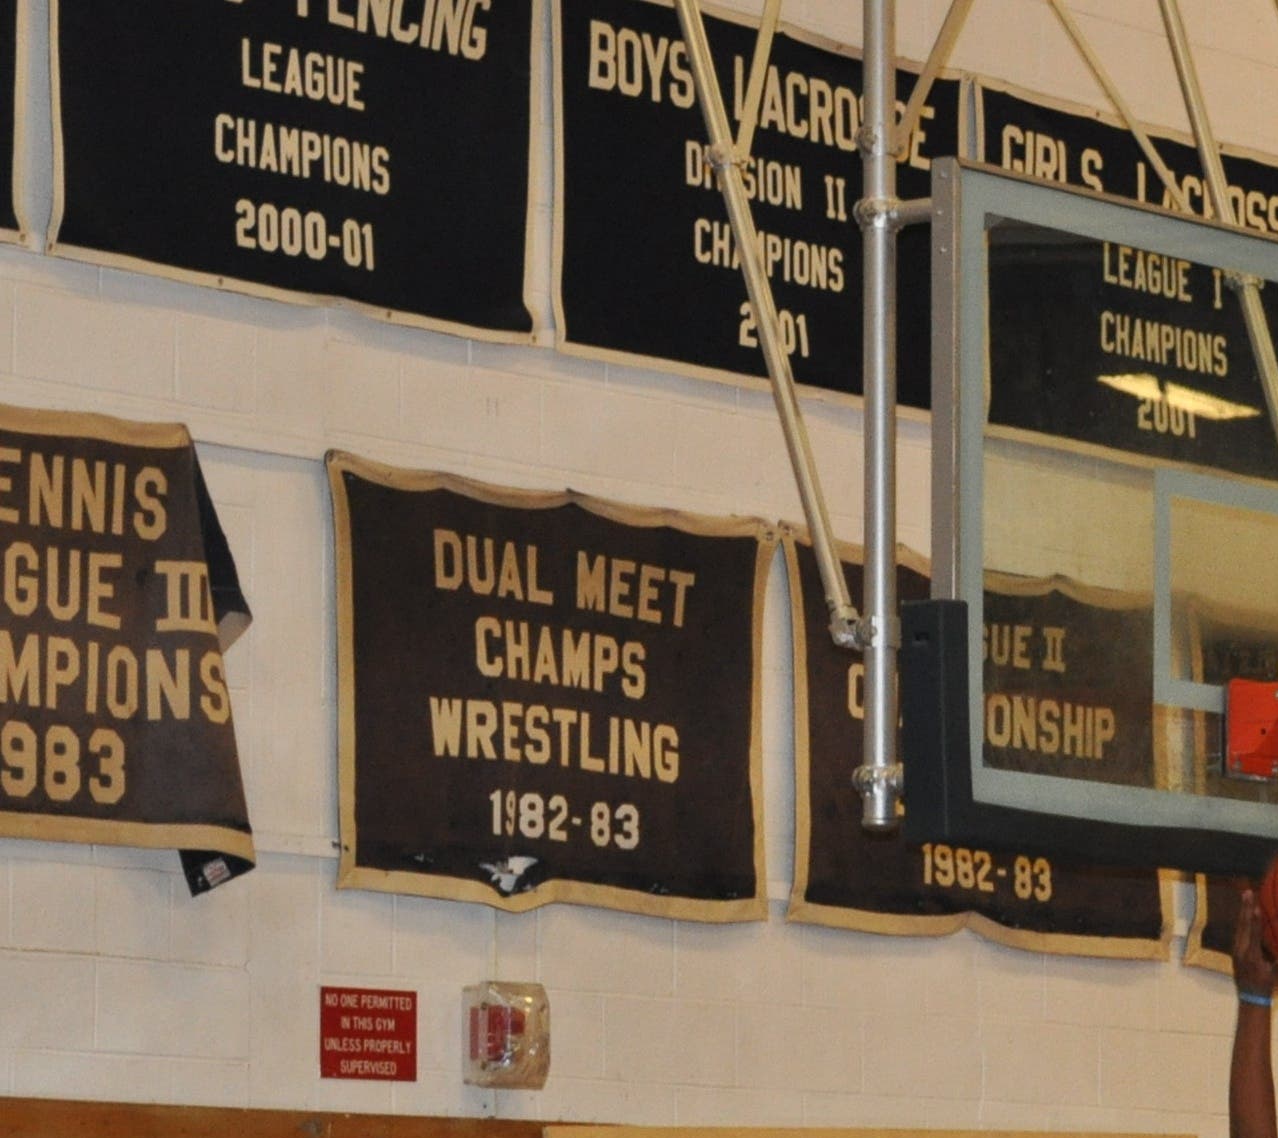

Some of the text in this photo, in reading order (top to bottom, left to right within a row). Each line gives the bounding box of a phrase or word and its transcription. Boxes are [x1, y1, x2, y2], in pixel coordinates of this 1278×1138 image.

[241, 37, 366, 111] LEAGUE
[588, 19, 935, 171] BOYS LACROE
[215, 113, 390, 194] CHAMPIONS
[685, 139, 847, 222] DISION II
[235, 198, 376, 271] 2000-01
[694, 217, 845, 292] CHPIONS
[1103, 242, 1193, 303] LEAGUE
[738, 302, 810, 358] 201
[1101, 311, 1229, 377] CHAMPIONS
[0, 446, 168, 541] ENNIS
[4, 541, 122, 630] GUE
[433, 528, 695, 628] DUAL MEET
[0, 630, 231, 725] MPIONS
[474, 615, 647, 700] CHAMPS
[2, 720, 126, 805] 983
[428, 695, 681, 785] WRESTLING
[489, 788, 641, 851] 1982-83
[921, 842, 1053, 902] 1982-83
[325, 993, 413, 1011] NO ONE PERMITTED
[341, 1016, 395, 1031] IN THIS GYM
[324, 1037, 412, 1055] UNLESS PROPERLY
[339, 1060, 398, 1076] SUPERVISED
